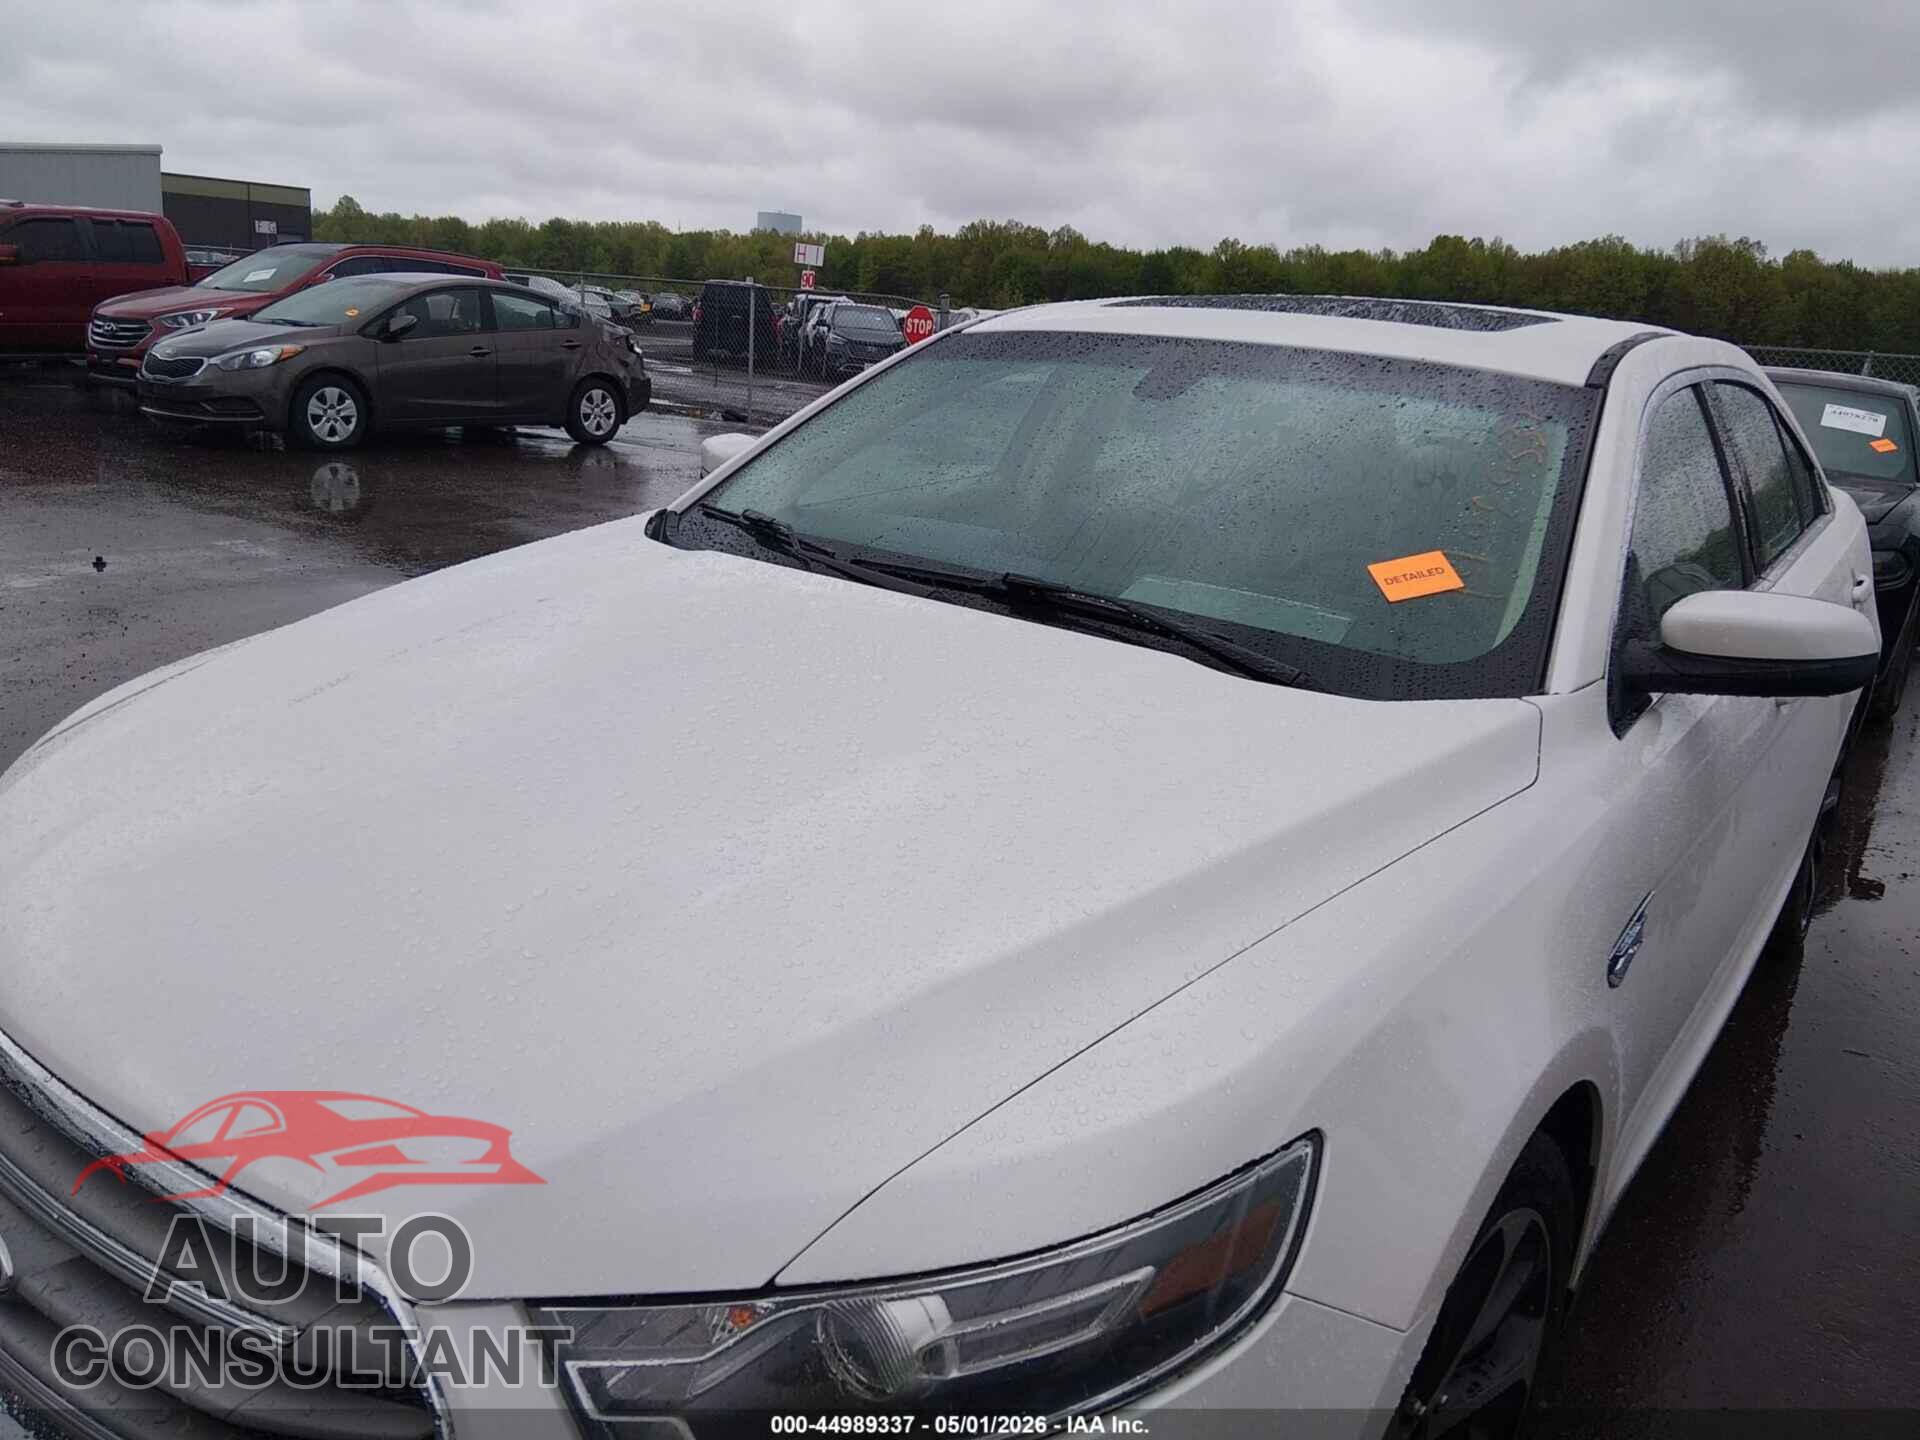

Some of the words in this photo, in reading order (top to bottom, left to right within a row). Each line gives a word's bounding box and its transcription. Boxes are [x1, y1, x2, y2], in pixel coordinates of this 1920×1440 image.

[802, 272, 815, 288] 90
[906, 318, 933, 335] STOP
[1384, 567, 1445, 585] DETAILED
